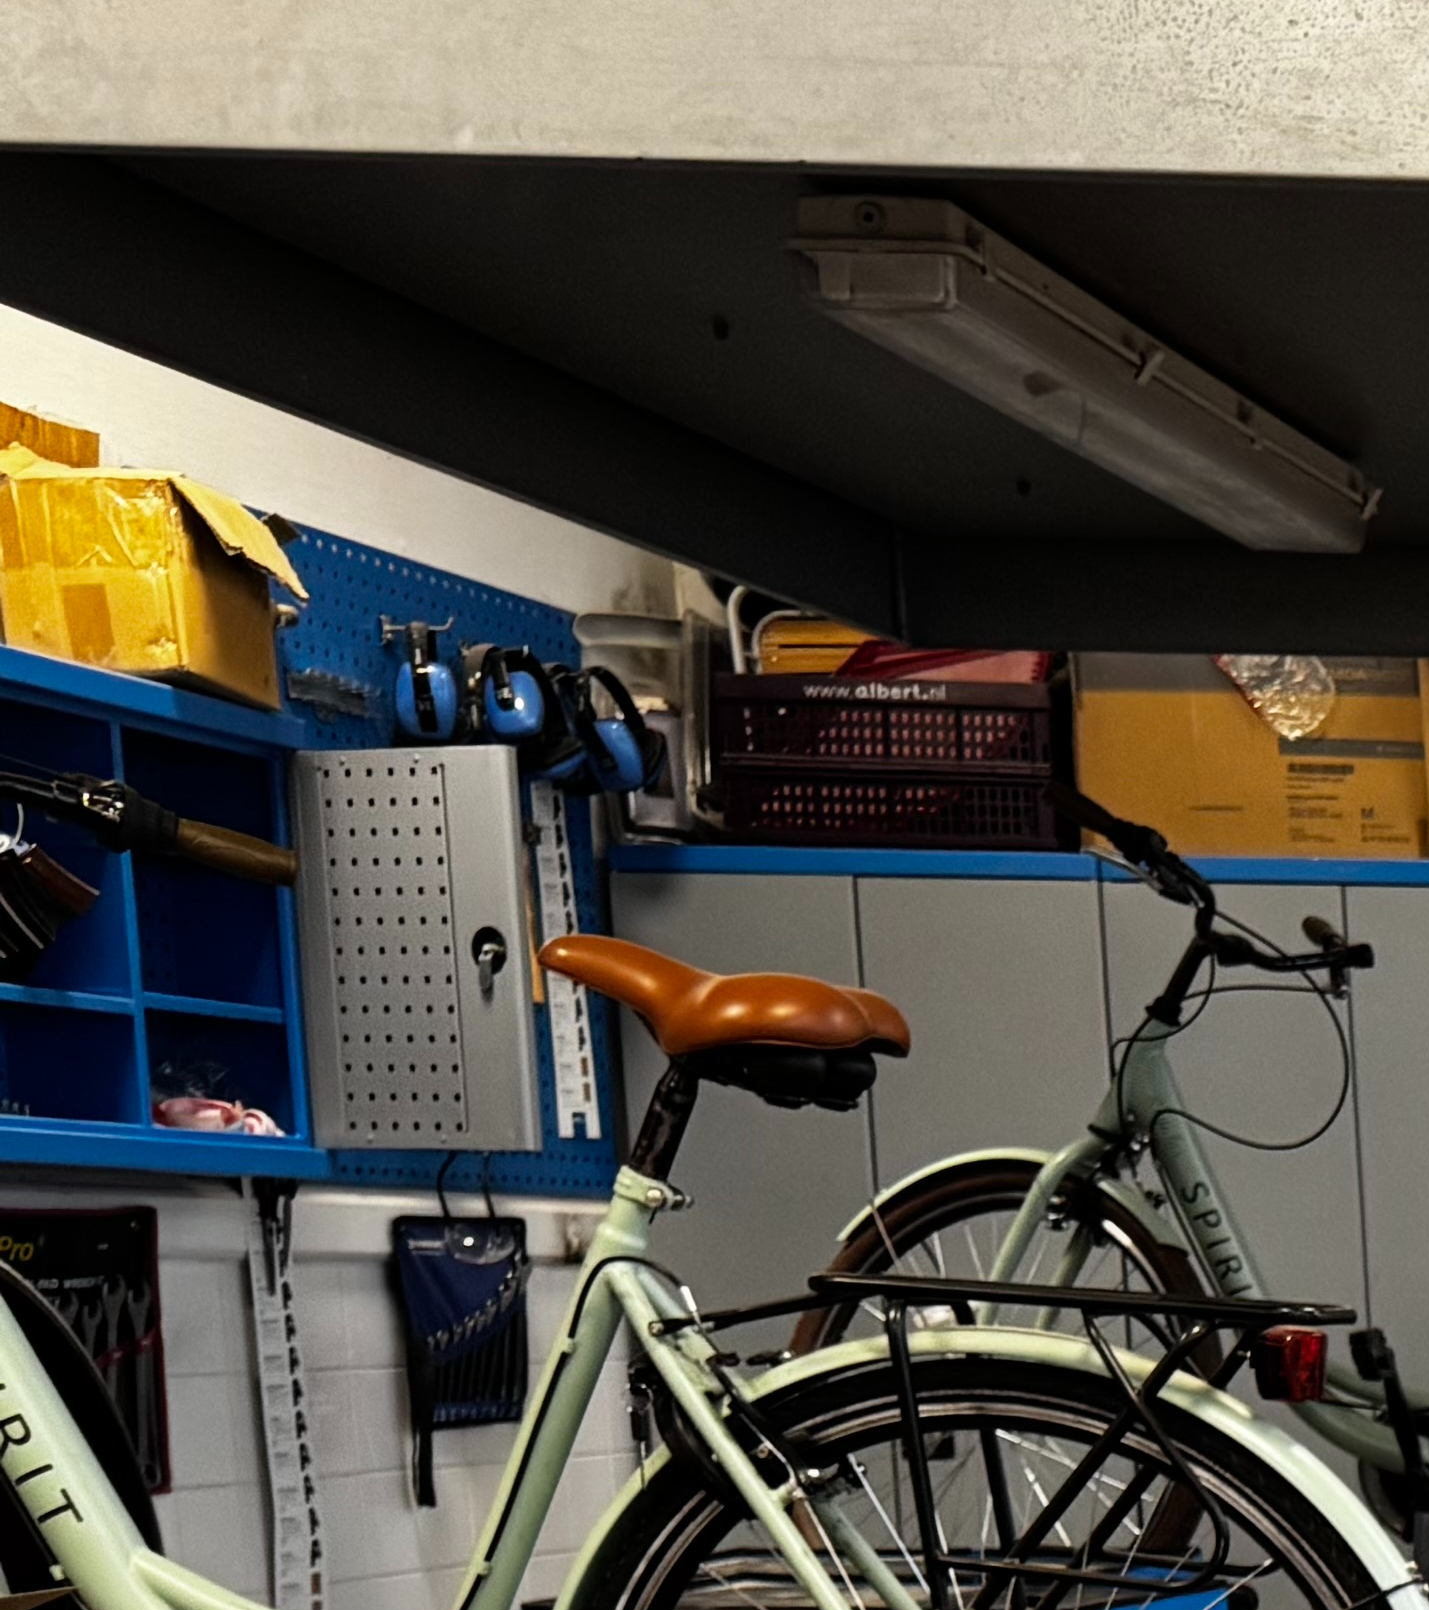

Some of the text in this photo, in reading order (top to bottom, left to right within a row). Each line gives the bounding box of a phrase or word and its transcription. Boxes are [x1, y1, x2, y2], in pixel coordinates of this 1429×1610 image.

[802, 682, 946, 700] www.albert.nl
[1180, 1181, 1253, 1296] SPIRI
[0, 1383, 84, 1524] RIT
